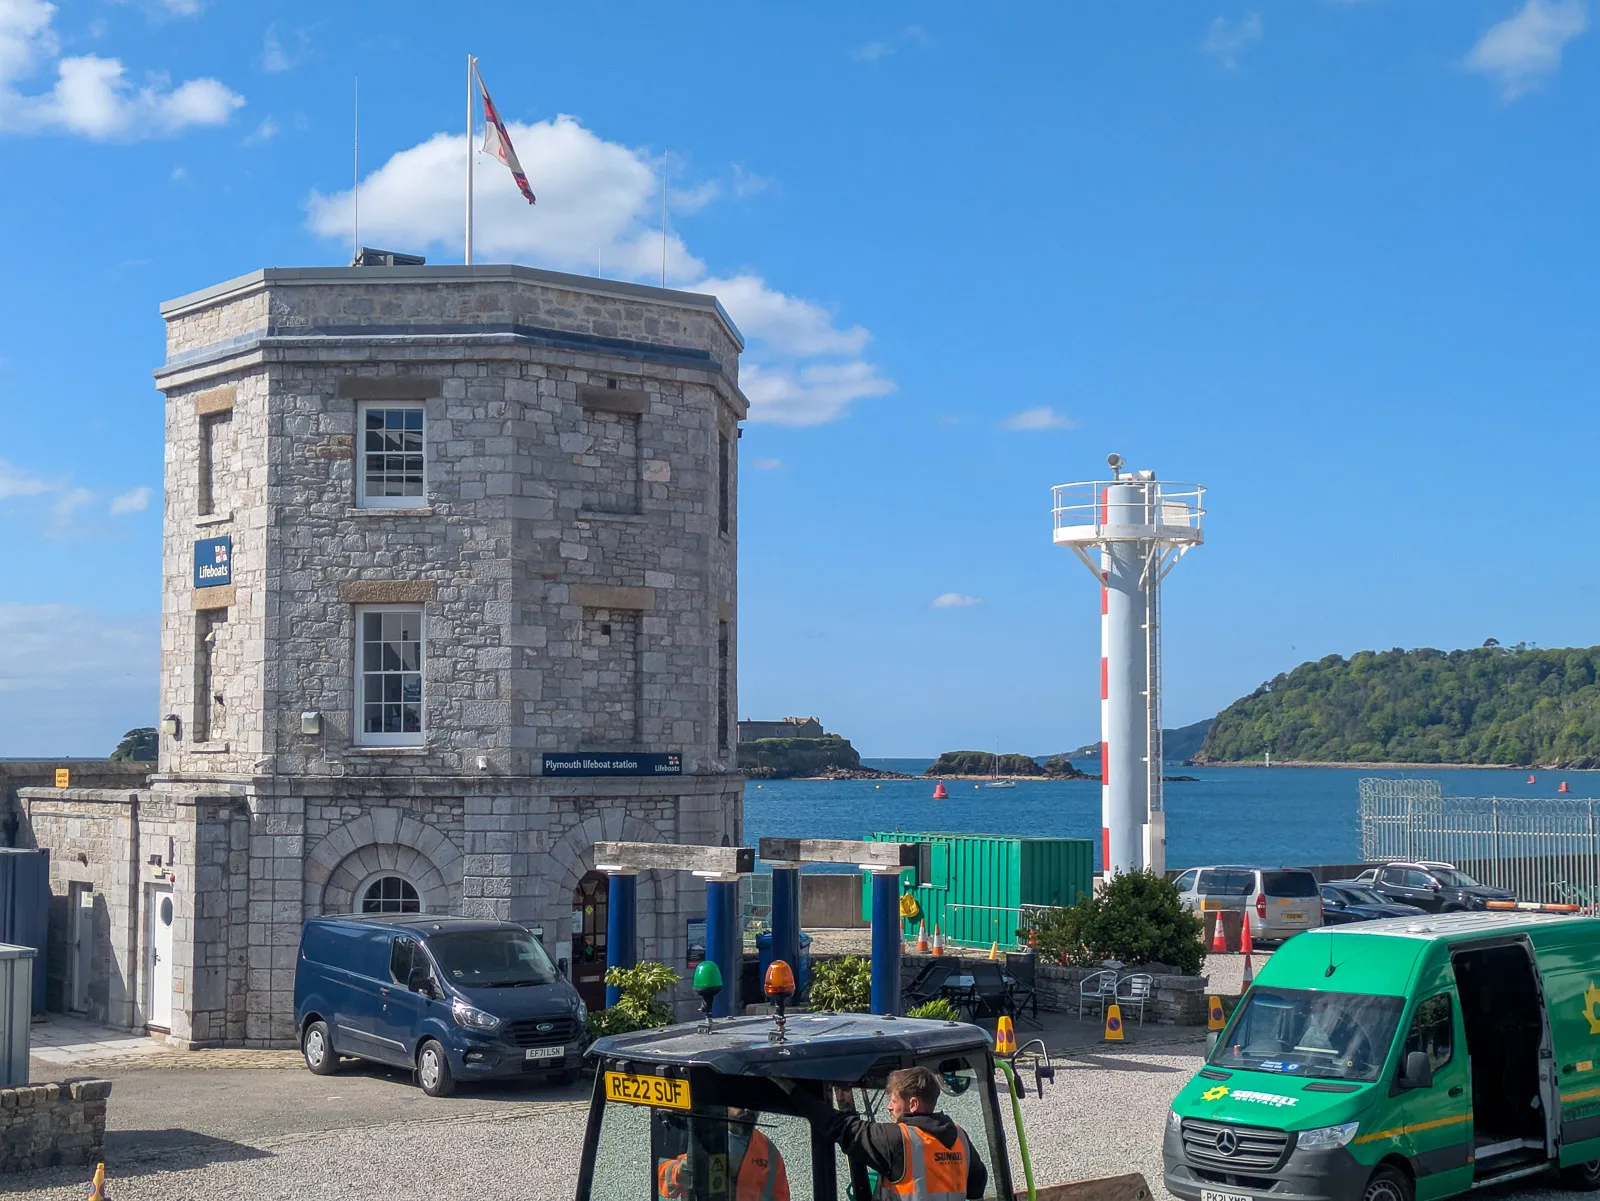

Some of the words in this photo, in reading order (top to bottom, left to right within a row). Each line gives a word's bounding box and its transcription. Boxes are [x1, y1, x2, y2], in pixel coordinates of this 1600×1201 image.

[199, 564, 228, 579] Lifeboats
[545, 760, 581, 771] Plymouth
[583, 760, 611, 769] lifeboat
[612, 760, 638, 769] station
[612, 1076, 650, 1100] RE22
[654, 1081, 682, 1104] SUF
